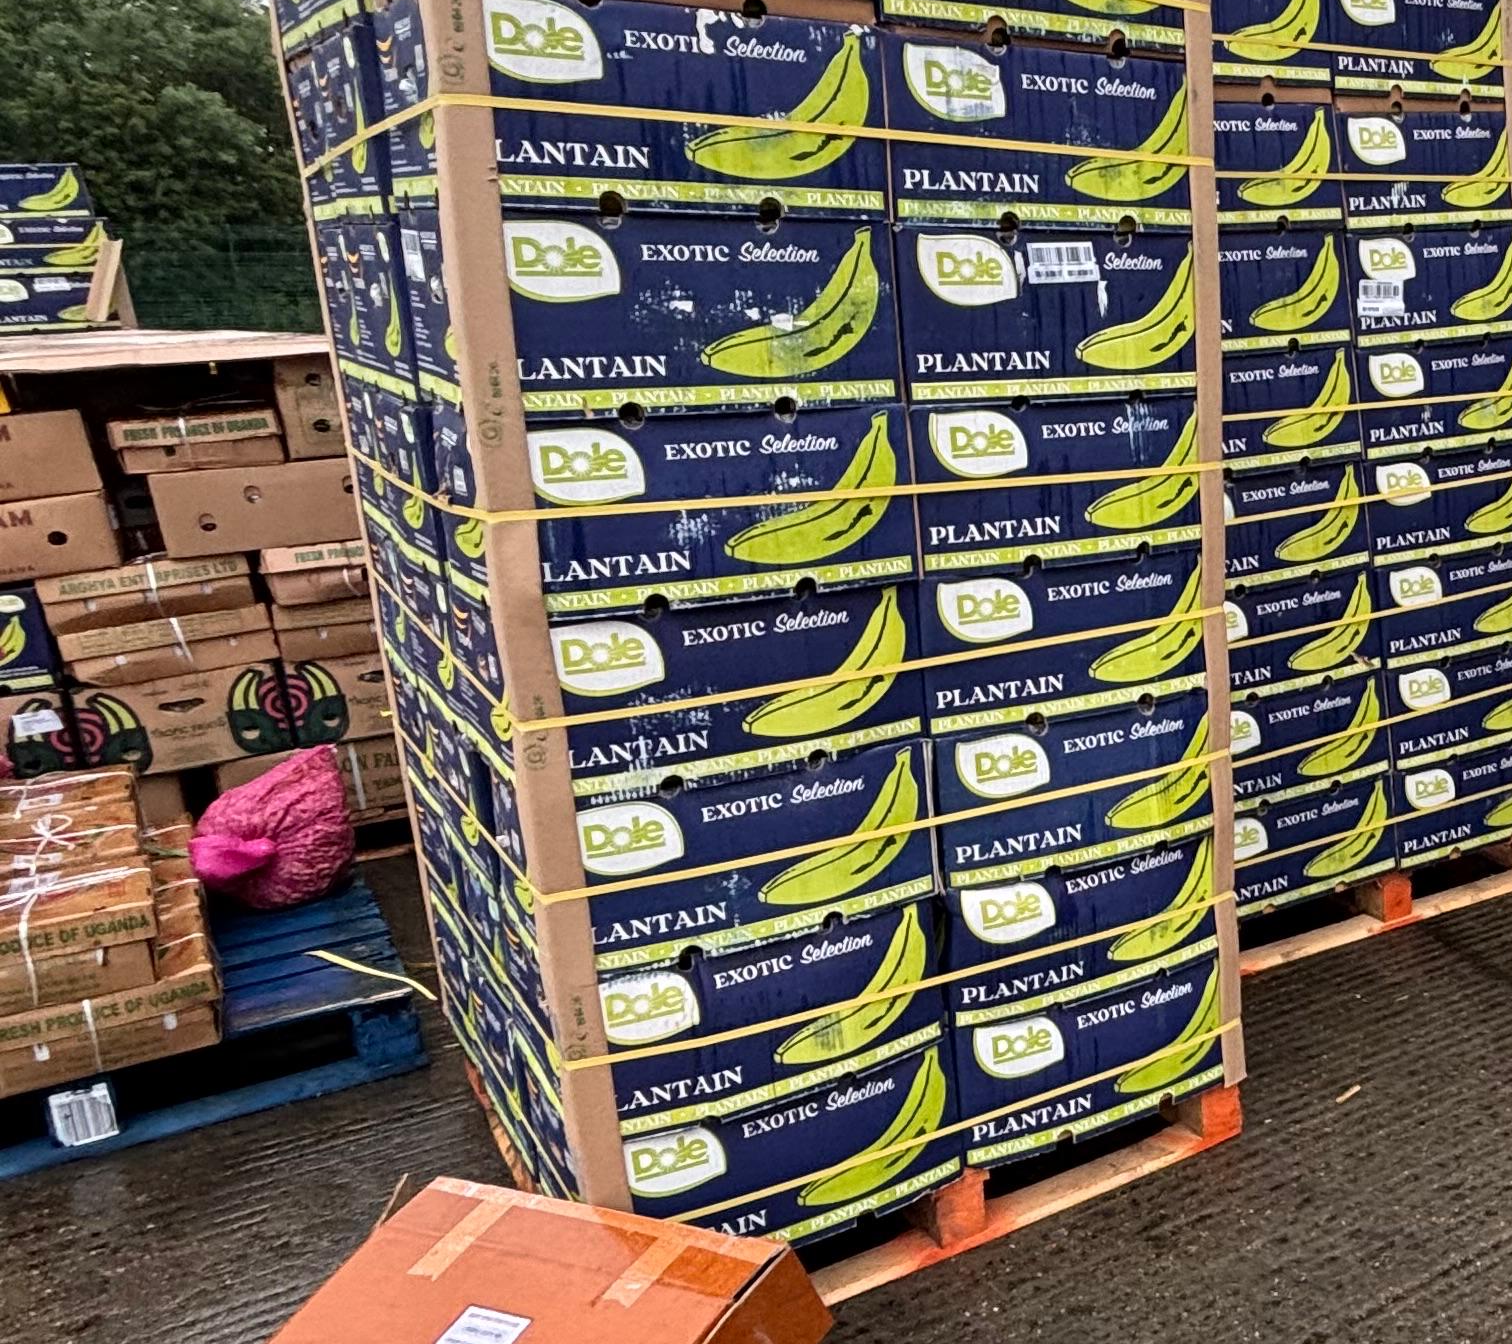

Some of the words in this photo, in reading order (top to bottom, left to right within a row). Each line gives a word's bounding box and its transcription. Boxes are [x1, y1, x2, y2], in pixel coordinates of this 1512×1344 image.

[490, 11, 584, 56] Dole
[625, 30, 703, 53] EXOTI
[724, 36, 807, 63] Selection
[1338, 56, 1414, 78] PLANTAIN
[1021, 73, 1089, 94] EXOTIC
[1095, 77, 1156, 100] Selection
[1359, 127, 1397, 146] Dole
[1413, 129, 1452, 141] EXOTIC
[496, 138, 650, 169] LANTAIN
[903, 168, 1039, 194] PLANTAIN
[806, 193, 881, 209] PLANTAIN
[512, 236, 601, 272] Dole
[641, 244, 730, 262] EXOTIC
[738, 242, 819, 264] Selection
[935, 251, 1003, 281] Dole
[1104, 253, 1162, 271] Selection
[1370, 249, 1407, 267] Dole
[517, 356, 666, 381] LANTAIN
[917, 350, 1051, 373] PLANTAIN
[1230, 368, 1274, 383] EXOTIC
[1278, 363, 1320, 377] Selection
[1380, 362, 1417, 380] Dole
[820, 382, 891, 397] PLANTAIN
[950, 425, 1015, 455] Dole
[1042, 422, 1106, 439] EXOTIC
[1112, 416, 1169, 434] Selection
[1370, 421, 1444, 442] PLANTAIN
[541, 442, 627, 479] Dole
[665, 440, 750, 460] EXOTIC
[759, 434, 838, 455] Selection
[1242, 487, 1285, 502] EXOTIC
[1289, 480, 1330, 494] Selection
[929, 516, 1061, 545] PLANTAIN
[1376, 527, 1450, 549] PLANTAIN
[543, 551, 692, 583] LANTAIN
[839, 560, 908, 576] PLANTAIN
[1048, 582, 1110, 602] EXOTIC
[1116, 572, 1173, 592] Selection
[1400, 576, 1435, 595] Dole
[957, 590, 1020, 622] Dole
[1257, 596, 1298, 616] EXOTIC
[683, 621, 765, 646] EXOTIC
[774, 610, 849, 632] Selection
[561, 632, 646, 670] Dole
[936, 673, 1063, 709] PLANTAIN
[1409, 675, 1445, 695] Dole
[570, 730, 708, 769] LANTAIN
[1063, 730, 1124, 754] EXOTIC
[1130, 717, 1184, 740] Selection
[1400, 727, 1469, 754] PLANTAIN
[976, 746, 1037, 779] Dole
[702, 793, 783, 822] EXOTIC
[791, 776, 864, 804] Selection
[1415, 775, 1449, 797] Dole
[583, 816, 665, 853] Dole
[1277, 810, 1318, 829] EXOTIC
[956, 824, 1082, 863] PLANTAIN
[1403, 824, 1472, 853] PLANTAIN
[1066, 867, 1125, 894] EXOTIC
[1131, 849, 1183, 875] Selection
[864, 880, 929, 907] PLANTAIN
[980, 891, 1041, 924] Dole
[59, 928, 79, 943] OF
[83, 915, 150, 938] UGANDA
[591, 901, 727, 944] LANTAIN
[714, 955, 793, 989] EXOTIC
[801, 932, 873, 965] Selection
[961, 961, 1085, 1004] PLANTAIN
[124, 999, 143, 1013] OF
[605, 983, 684, 1022] Dole
[1077, 1000, 1135, 1030] EXOTIC
[1141, 982, 1193, 1009] Selection
[992, 1025, 1052, 1060] Dole
[615, 1066, 743, 1112] LANTAIN
[743, 1102, 818, 1139] EXOTIC
[826, 1076, 895, 1112] Selection
[972, 1094, 1092, 1142] PLANTAIN
[630, 1137, 709, 1176] Dole
[811, 1196, 879, 1228] PLANTAIN
[895, 1161, 956, 1196] PLANTAIN
